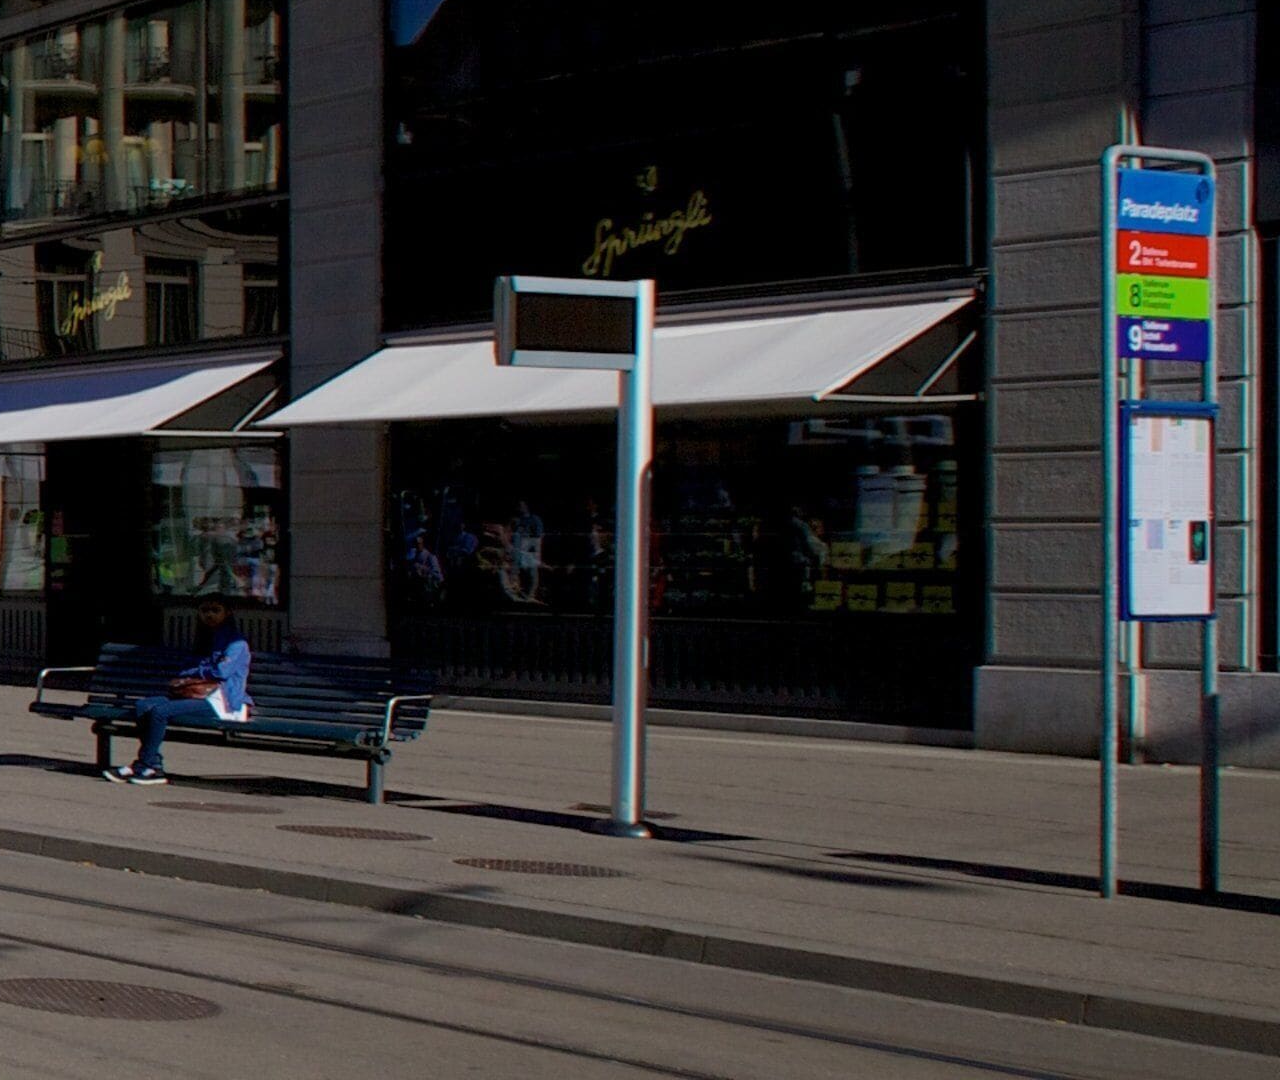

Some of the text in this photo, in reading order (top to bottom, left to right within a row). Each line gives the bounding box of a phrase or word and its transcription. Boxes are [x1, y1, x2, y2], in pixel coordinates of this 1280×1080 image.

[1120, 197, 1199, 224] Paradeplatz
[1128, 239, 1141, 266] 2
[1129, 283, 1141, 308] 8
[1128, 324, 1142, 352] 9
